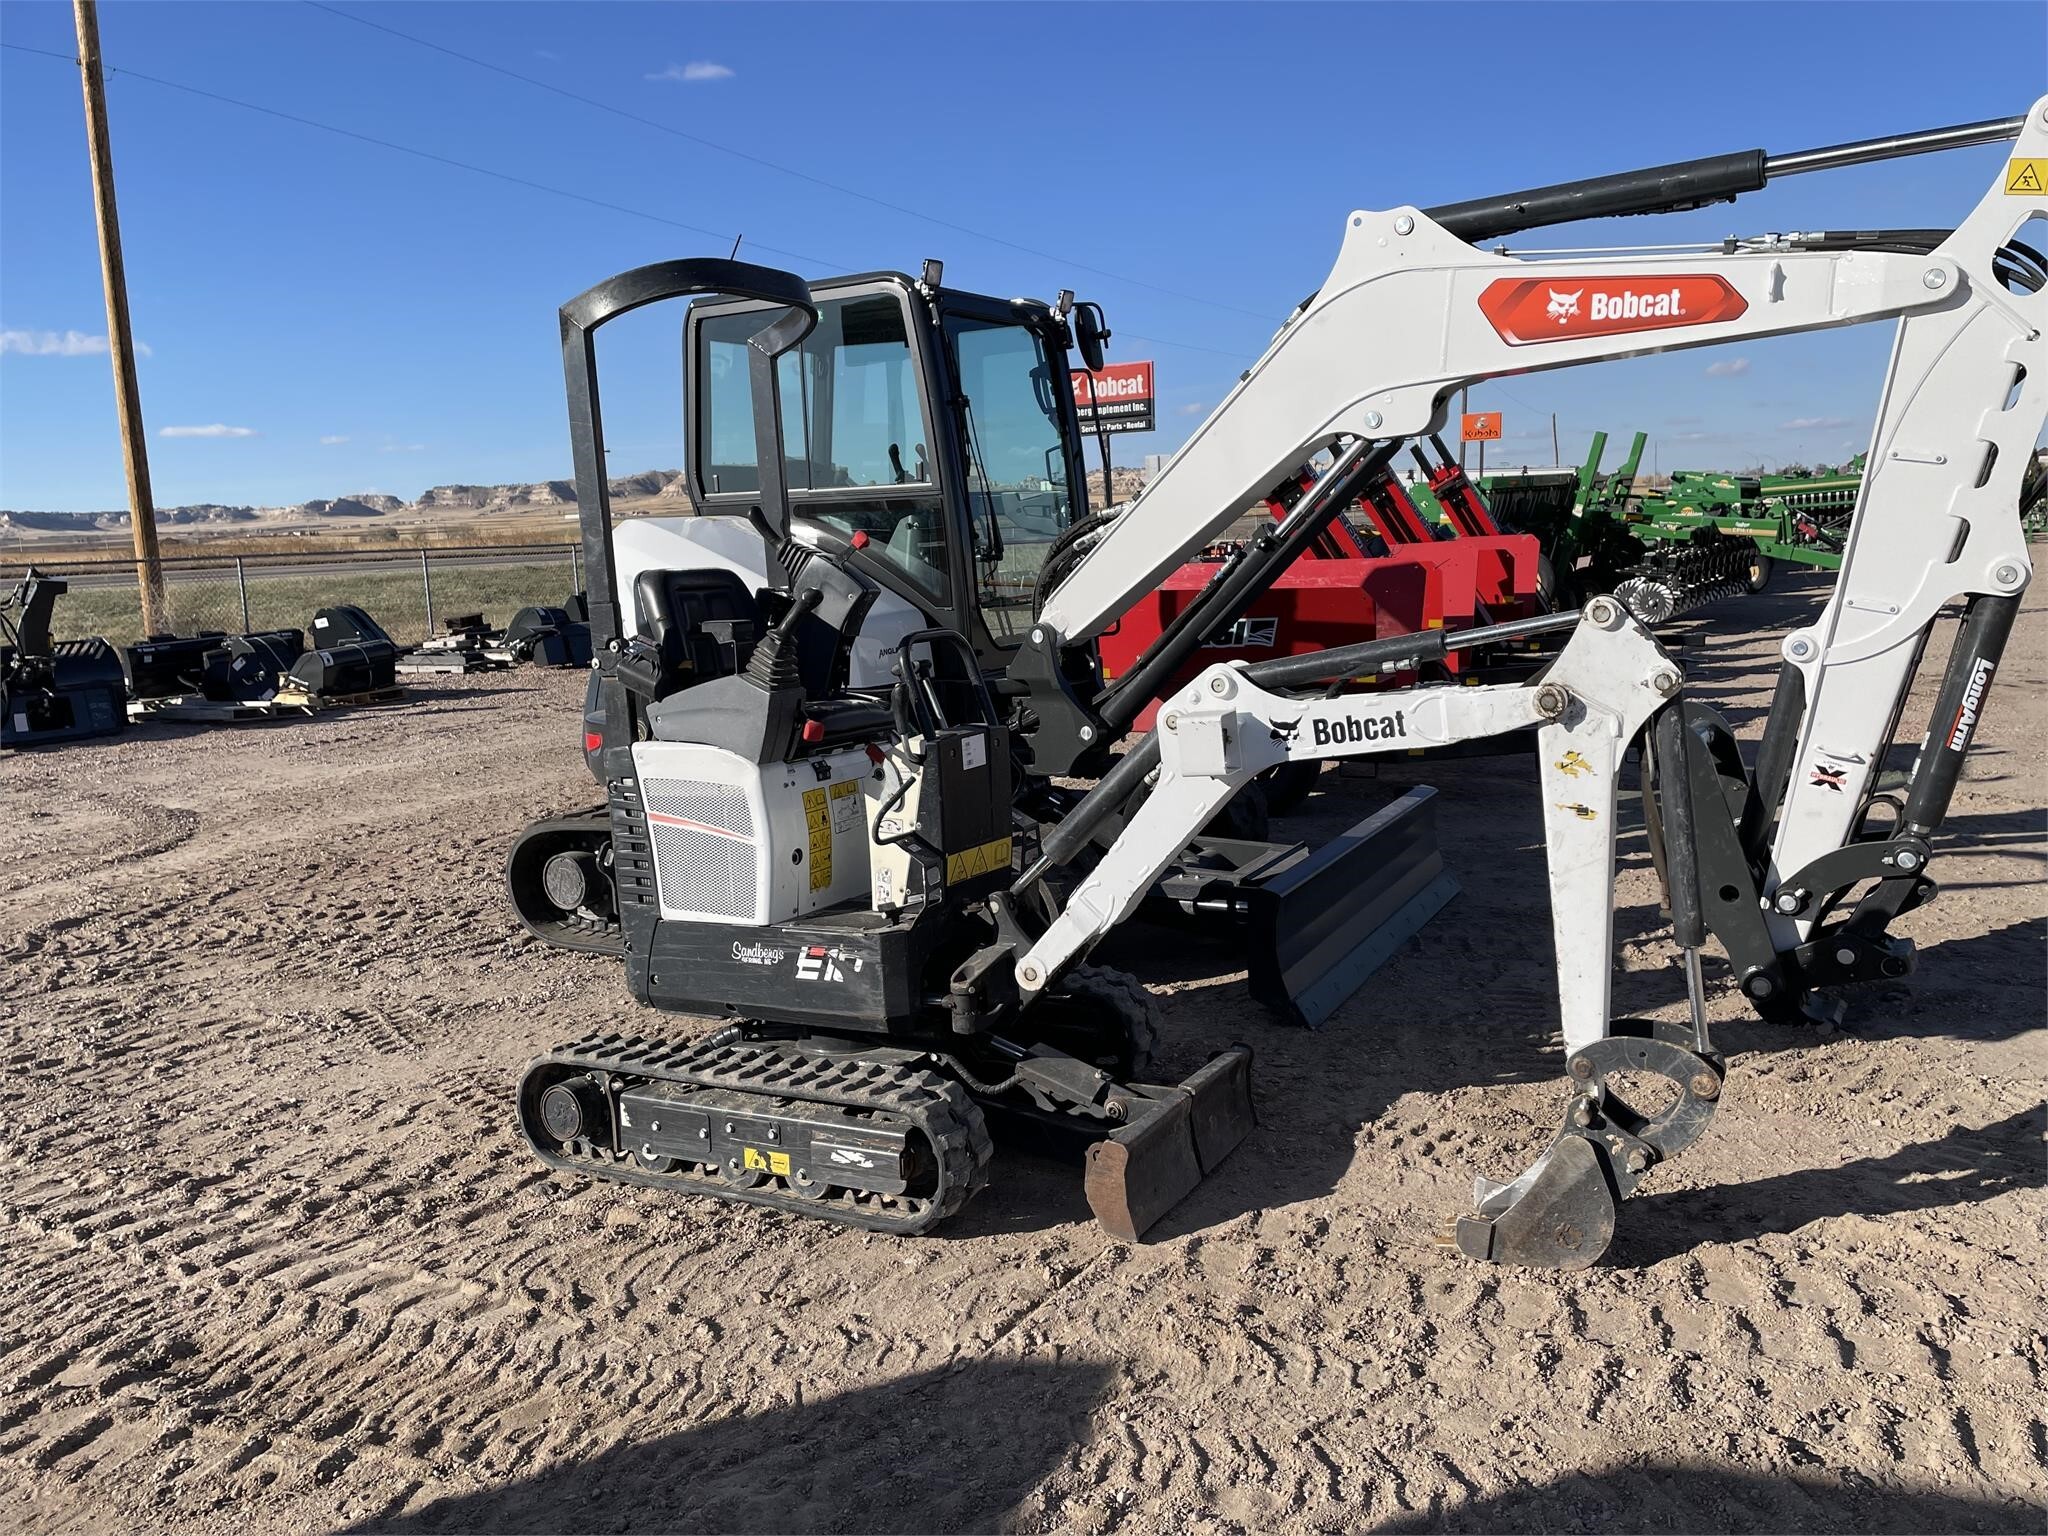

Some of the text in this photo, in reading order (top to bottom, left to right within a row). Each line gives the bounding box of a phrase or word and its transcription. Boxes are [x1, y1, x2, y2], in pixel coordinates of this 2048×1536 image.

[1590, 288, 1680, 320] Bobcat
[1087, 374, 1144, 399] Bobcat
[1132, 402, 1147, 412] Inc.
[1106, 422, 1122, 431] Parts
[1126, 420, 1146, 430] Rental
[1464, 429, 1498, 438] Kubota
[1949, 658, 1995, 752] LongArm
[1312, 710, 1407, 746] Bobcat
